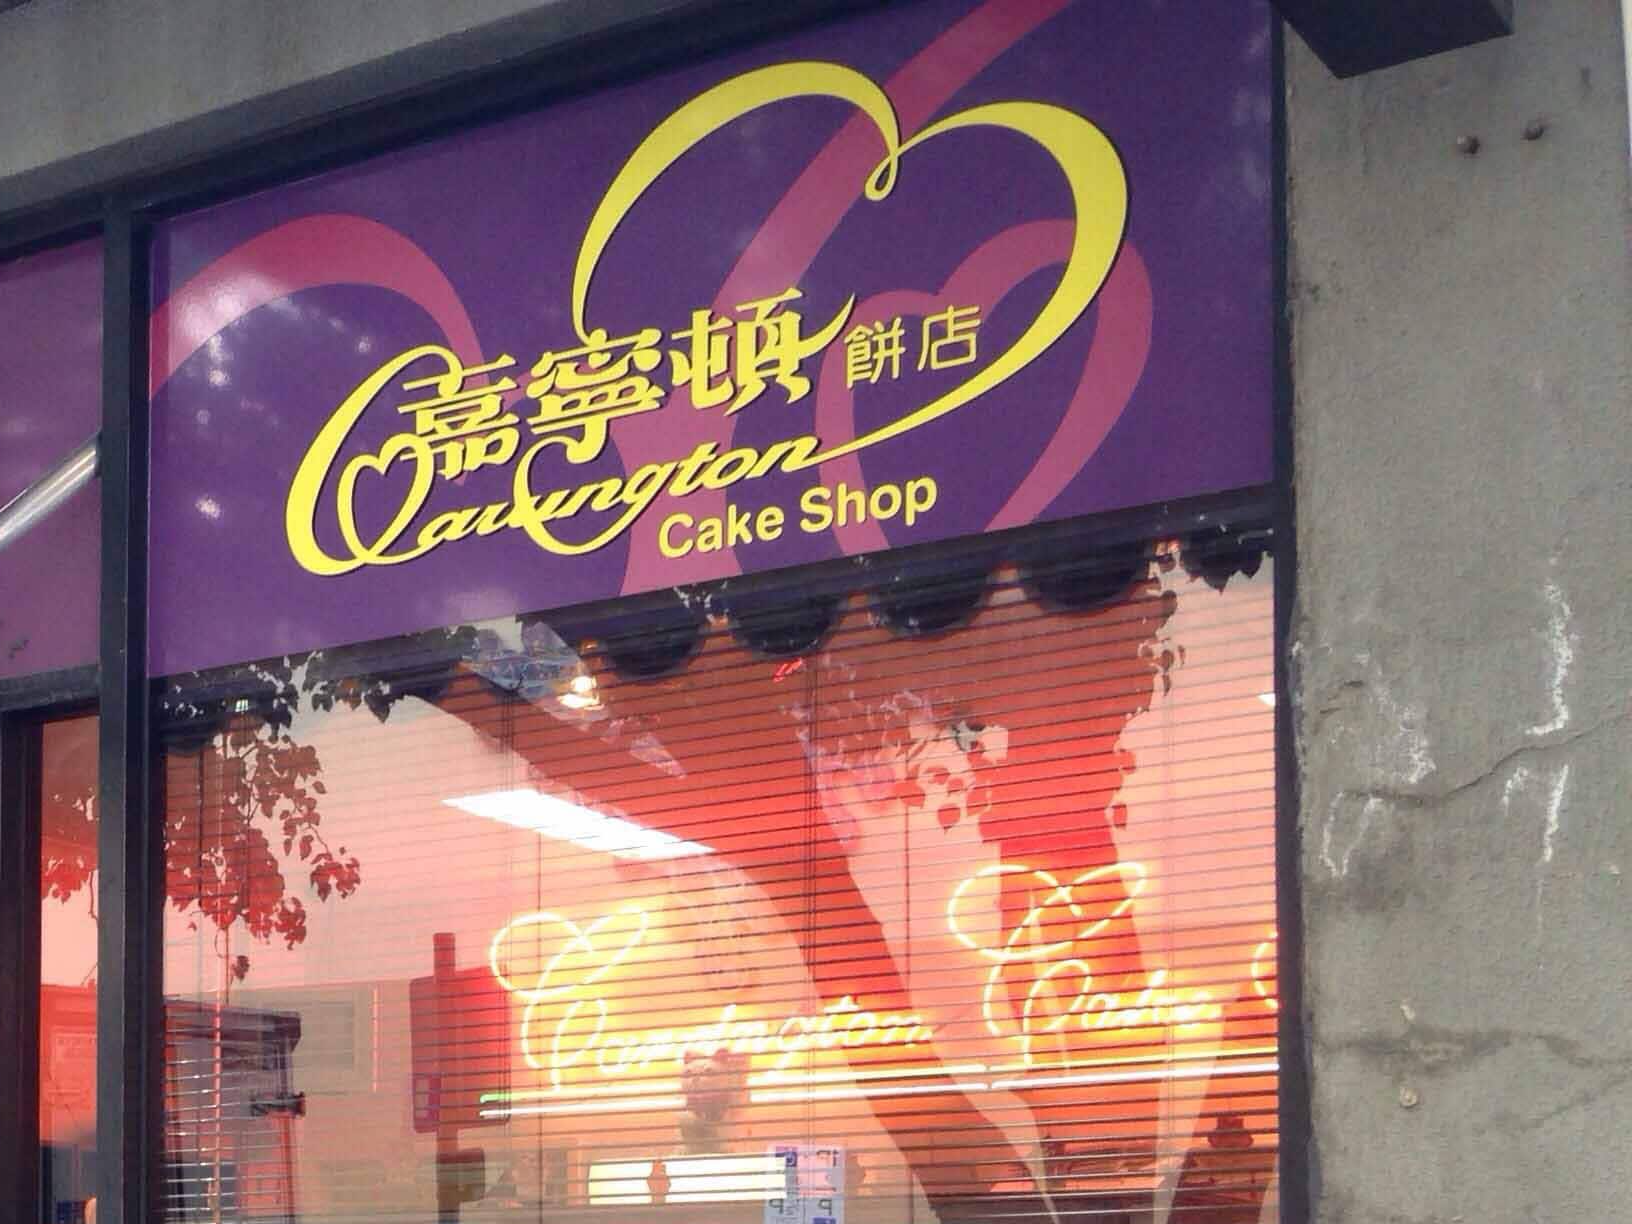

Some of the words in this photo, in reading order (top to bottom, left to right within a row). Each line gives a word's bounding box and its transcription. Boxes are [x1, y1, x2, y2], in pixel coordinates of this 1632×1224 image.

[398, 288, 855, 480] 嘉寧頓
[844, 305, 981, 388] 餅店
[658, 502, 784, 559] Cake
[799, 474, 939, 536] Shop
